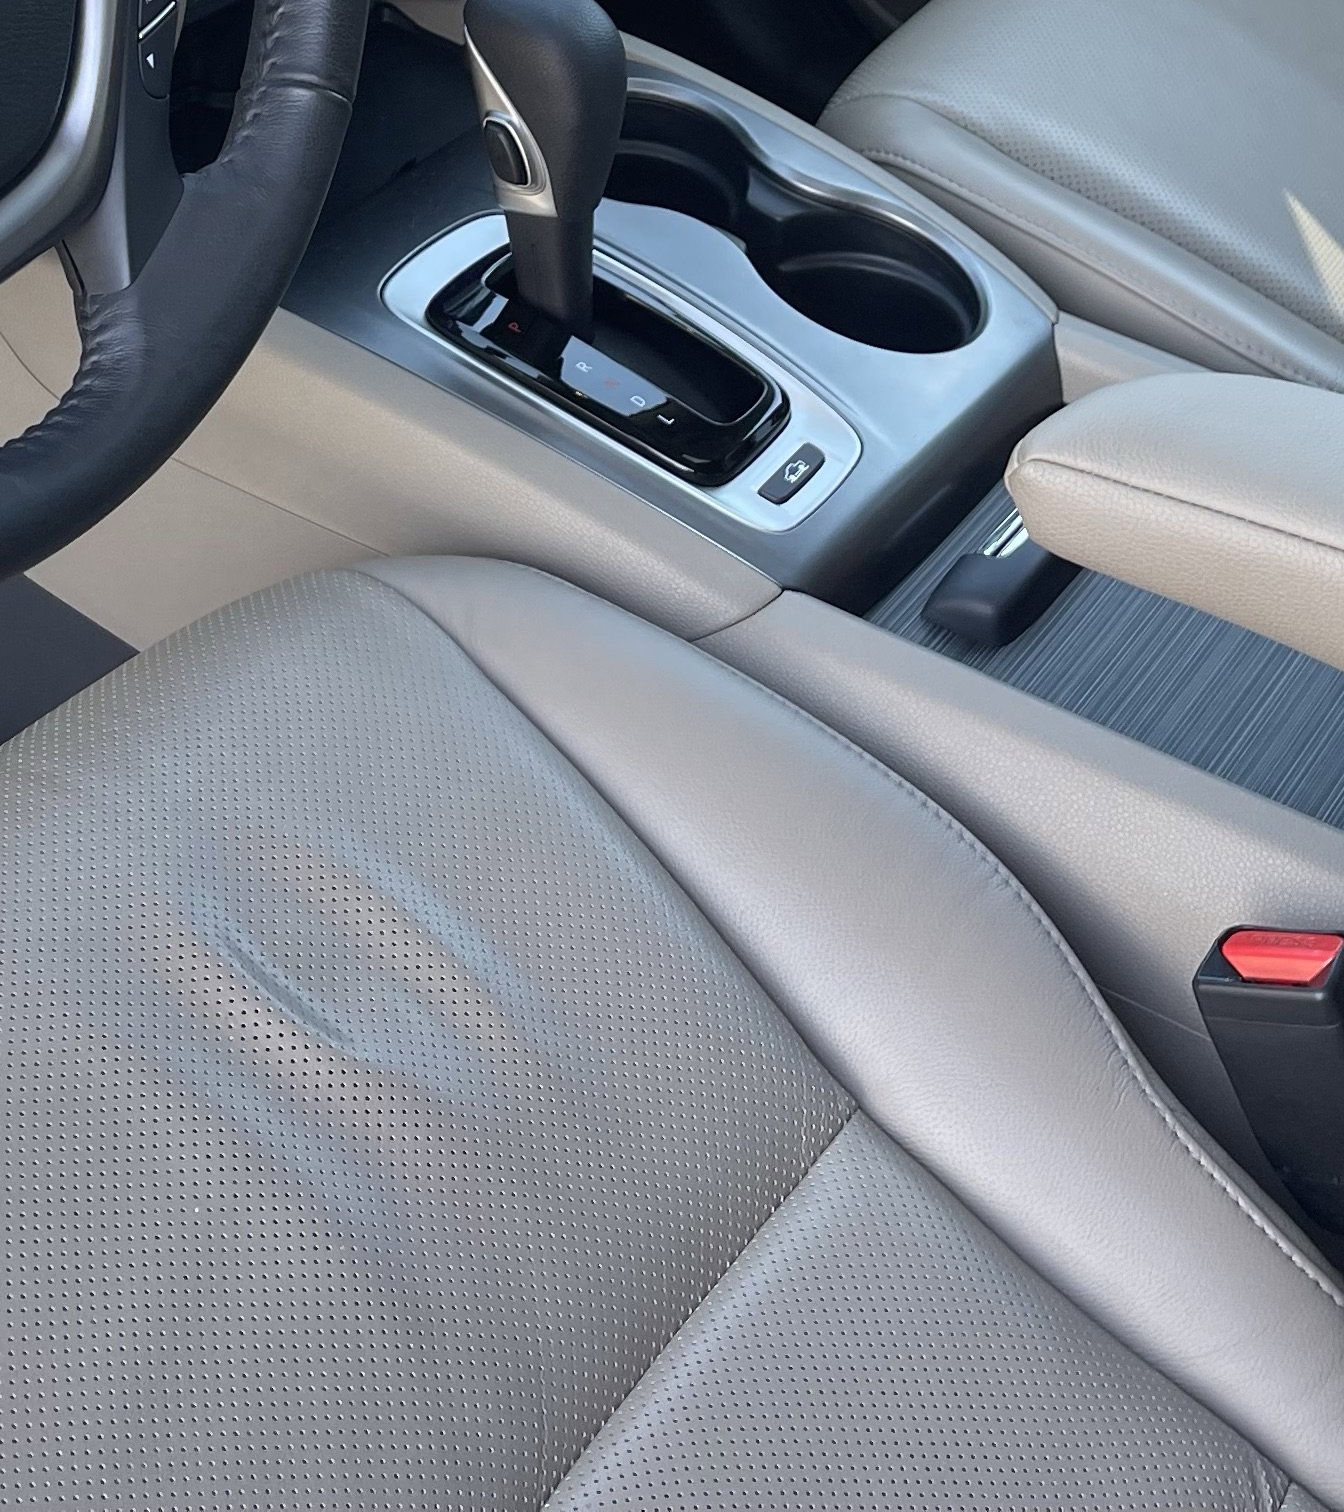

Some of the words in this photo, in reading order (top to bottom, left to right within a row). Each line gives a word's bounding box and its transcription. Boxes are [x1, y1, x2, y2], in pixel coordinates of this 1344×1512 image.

[575, 361, 592, 373] R
[630, 395, 646, 408] D
[657, 414, 675, 425] L
